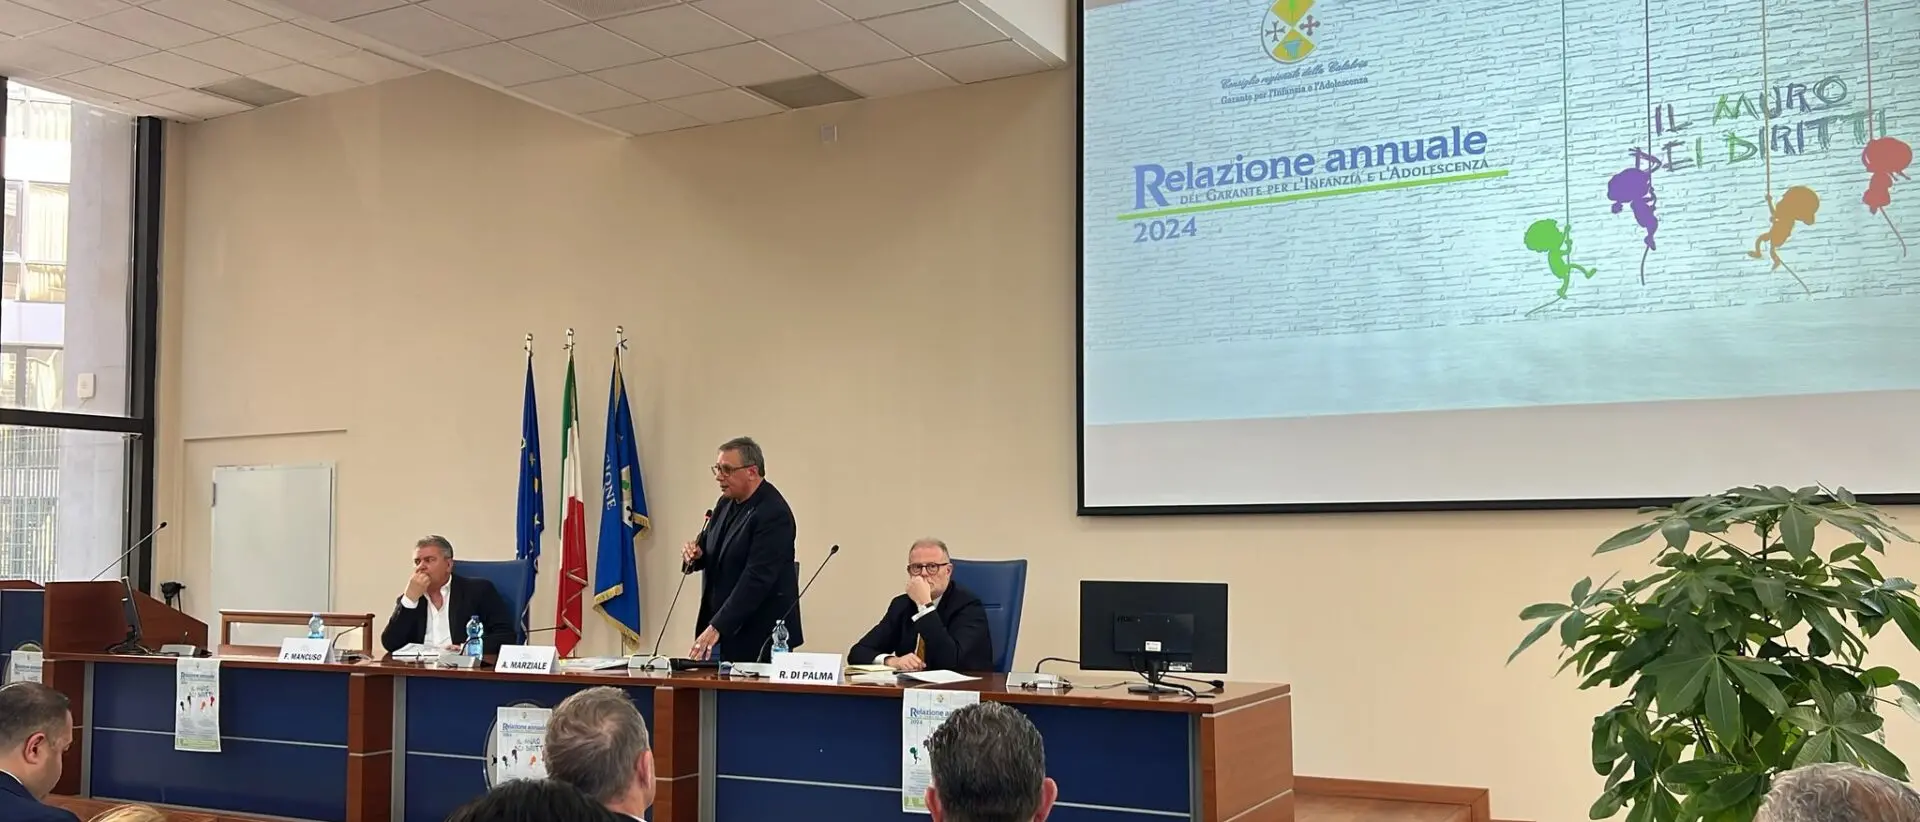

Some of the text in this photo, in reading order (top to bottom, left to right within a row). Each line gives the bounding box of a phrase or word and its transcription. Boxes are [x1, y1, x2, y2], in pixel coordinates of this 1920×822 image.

[1220, 74, 1260, 89] Consiglio
[1301, 64, 1324, 77] della
[1328, 58, 1368, 73] Calabria
[1221, 94, 1253, 104] Garante
[1253, 92, 1266, 102] per
[1268, 85, 1306, 98] l'Infanzia
[1314, 76, 1368, 91] l'Adolescenza
[1655, 75, 1848, 136] IL MURO
[1628, 108, 1887, 173] DEI DIRITTI
[1133, 126, 1488, 210] Relazione annuale
[1180, 158, 1489, 204] DEL GARANTE PER L'INFANZIA E L'ADOLESCENZA
[1133, 216, 1197, 243] 2024
[283, 652, 322, 661] F. MANCUSO
[510, 661, 547, 670] MARZIALE
[779, 670, 833, 681] R. DI PALMA
[910, 707, 944, 717] Relazione
